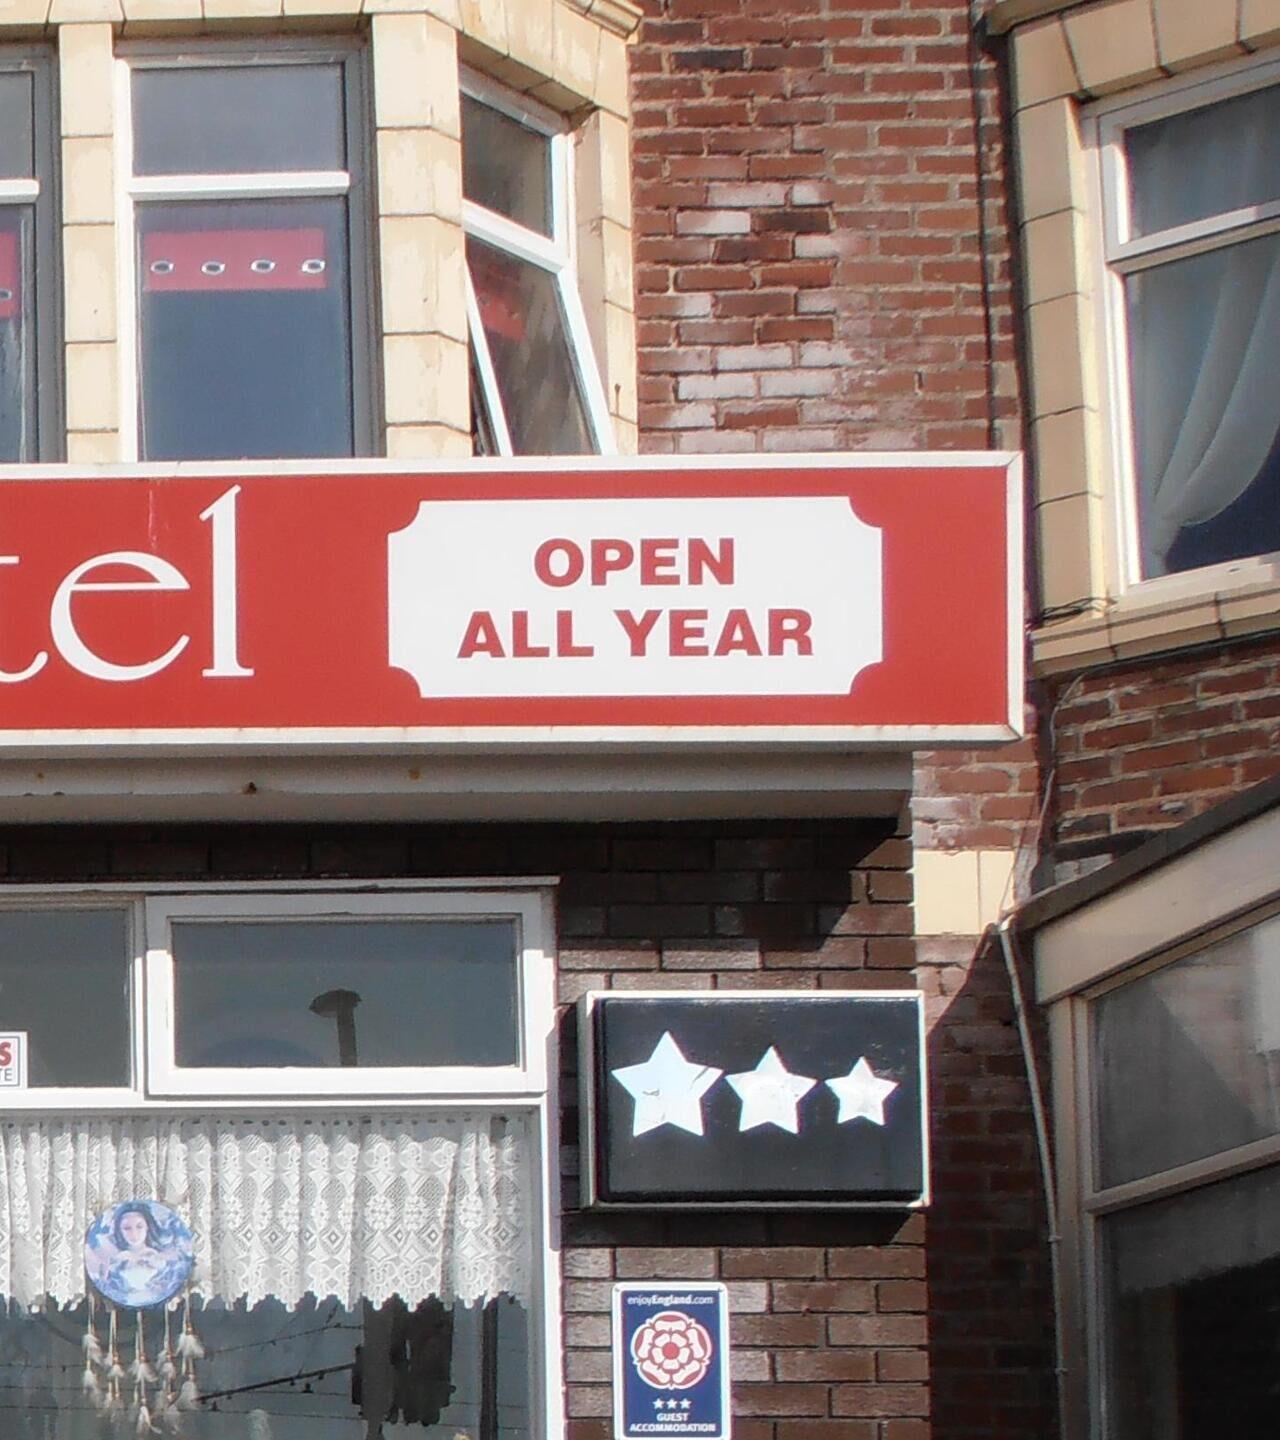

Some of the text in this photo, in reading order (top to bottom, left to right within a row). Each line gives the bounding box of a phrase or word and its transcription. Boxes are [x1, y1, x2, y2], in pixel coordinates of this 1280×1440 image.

[532, 538, 736, 588] OPEN
[457, 608, 815, 660] ALL YEAR
[627, 1294, 714, 1307] enjoyEngland.com
[656, 1412, 690, 1422] GUEST
[629, 1423, 717, 1433] ACCOMMODATION
